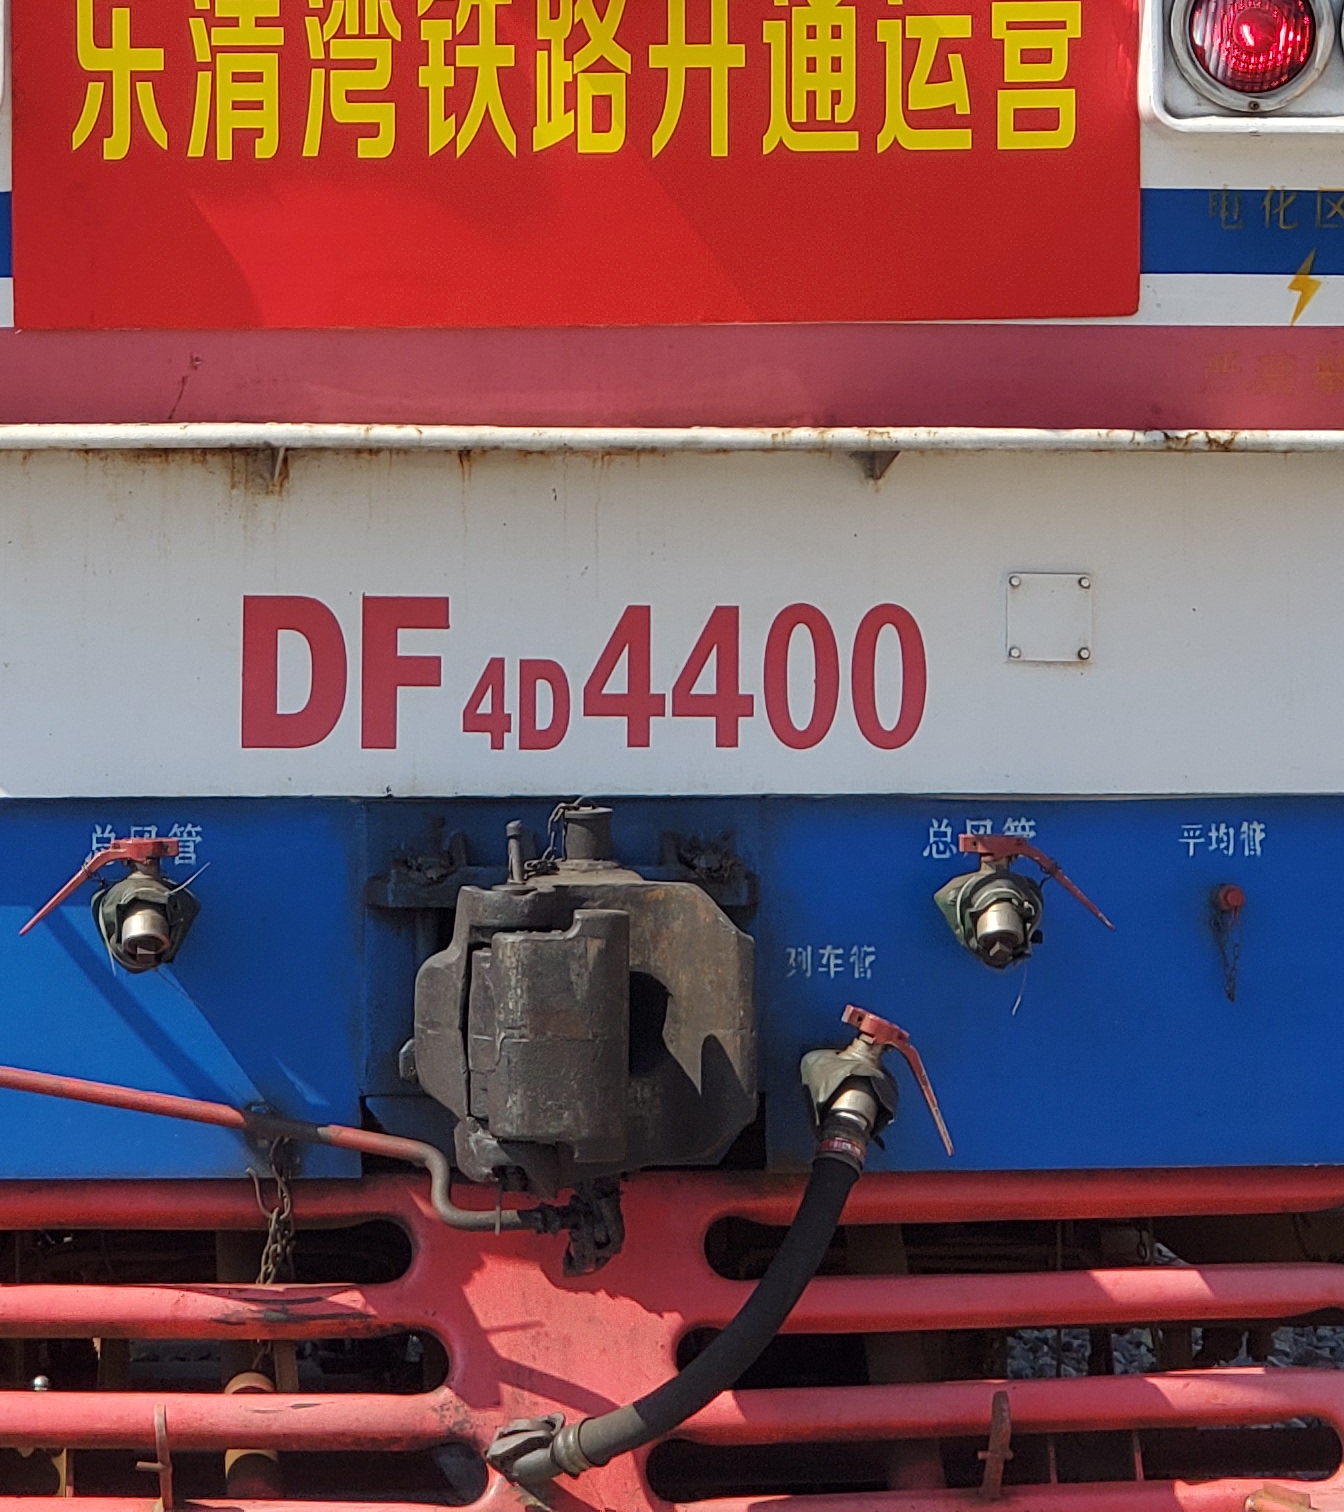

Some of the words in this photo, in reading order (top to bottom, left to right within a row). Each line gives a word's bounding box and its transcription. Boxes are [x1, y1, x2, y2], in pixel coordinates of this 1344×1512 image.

[1178, 820, 1266, 857] 平均管
[785, 944, 876, 980] 列车管
